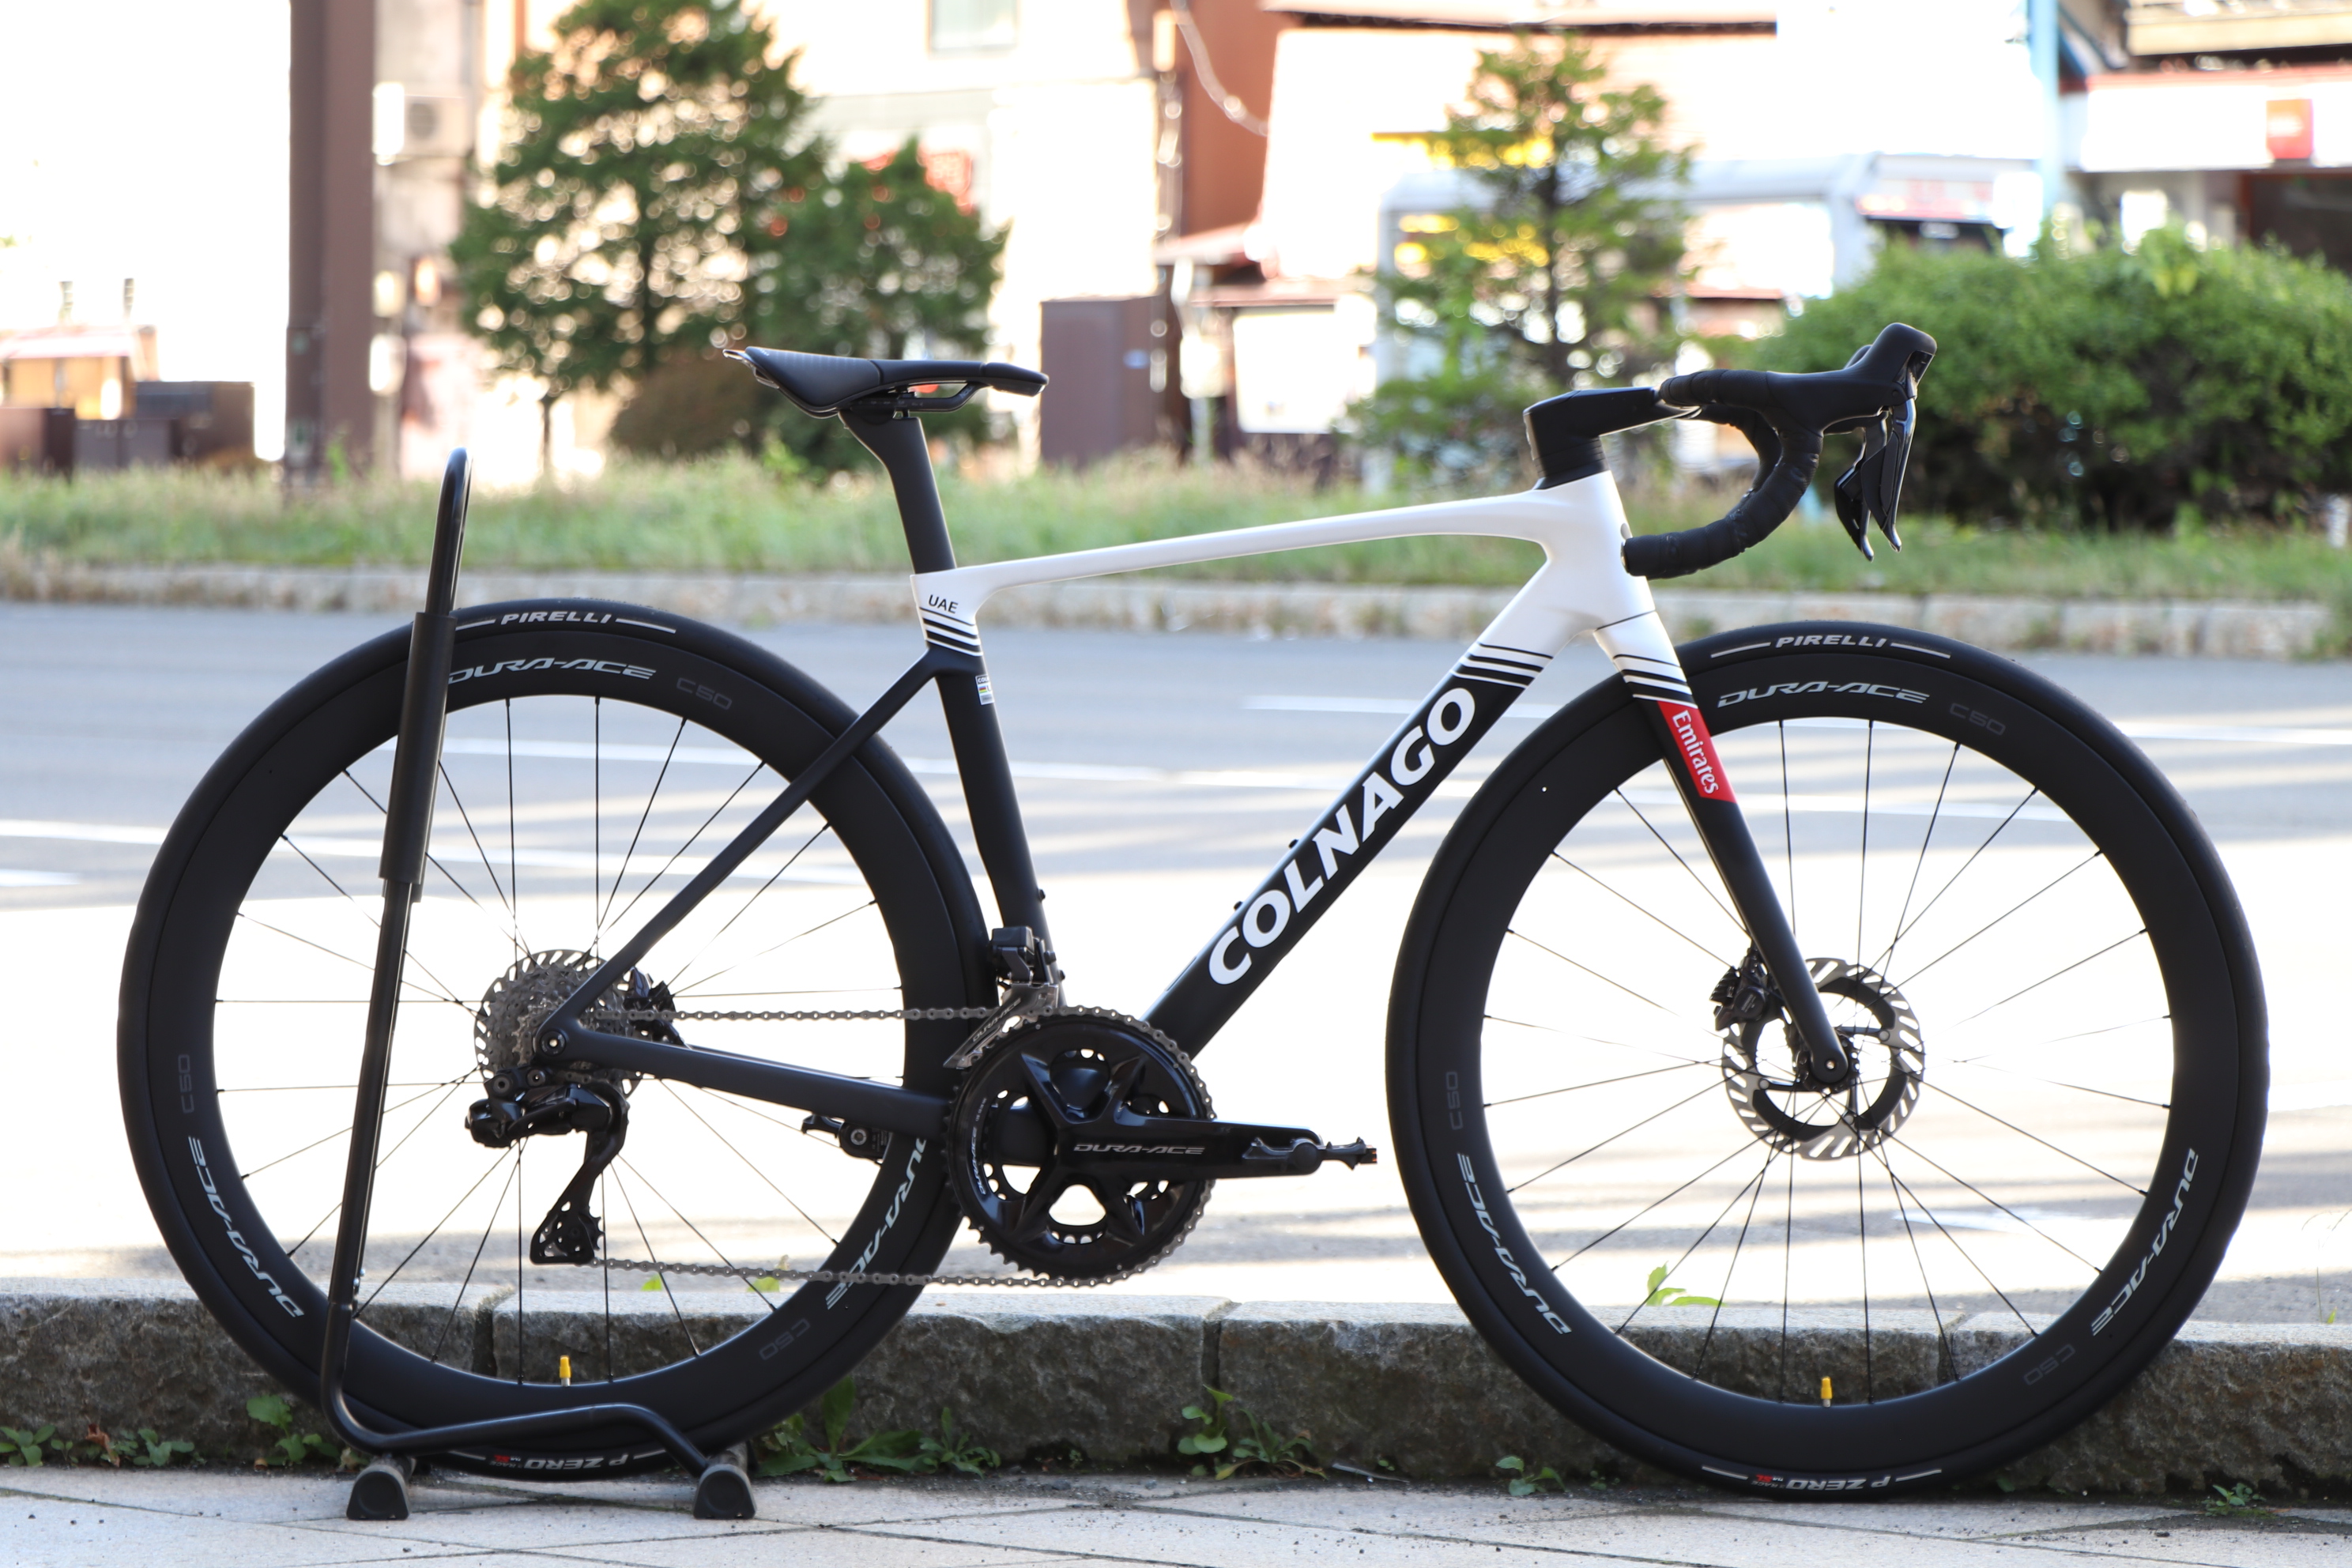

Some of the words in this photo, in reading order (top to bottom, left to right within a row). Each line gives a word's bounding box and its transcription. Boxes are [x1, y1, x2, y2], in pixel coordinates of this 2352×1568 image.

[500, 611, 612, 625] PIRELLI
[928, 594, 959, 613] UAE
[1775, 635, 1887, 648] PIRELLI
[447, 658, 657, 684] DURA-ACE
[676, 677, 733, 710] C50
[1717, 681, 1930, 708] DURA-ACE
[1949, 703, 2007, 736] C50
[1672, 710, 1719, 794] Emirates
[1208, 688, 1476, 986] COLNAGO
[178, 1054, 195, 1114] C50
[1446, 1071, 1463, 1131] C50
[1073, 1144, 1206, 1155] DURA-ACE
[187, 1136, 305, 1318] DURA-ACE
[1457, 1152, 1572, 1335] DURA-ACE
[2090, 1148, 2199, 1336] DURA-ACE
[759, 1318, 811, 1361] C50
[2023, 1344, 2076, 1386] C50
[523, 1457, 605, 1470] ZERO
[609, 1453, 629, 1466] P
[1786, 1478, 1868, 1491] ZERO
[1871, 1476, 1891, 1488] P
